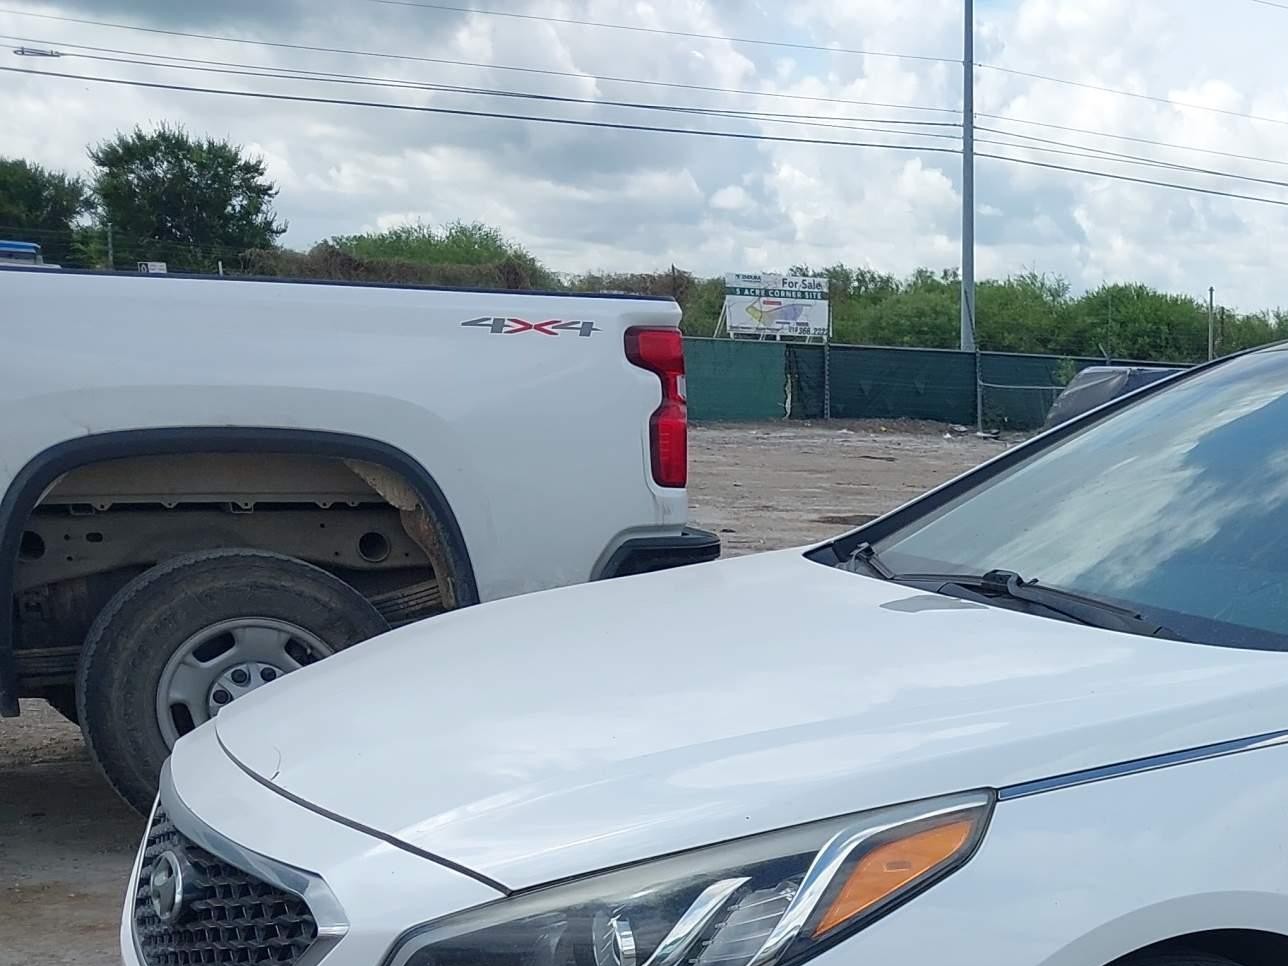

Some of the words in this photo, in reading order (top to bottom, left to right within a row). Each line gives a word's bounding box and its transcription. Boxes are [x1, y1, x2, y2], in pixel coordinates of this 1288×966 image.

[782, 278, 798, 289] For
[802, 279, 822, 290] Sale
[768, 289, 802, 298] CORNER
[805, 291, 822, 299] SITE
